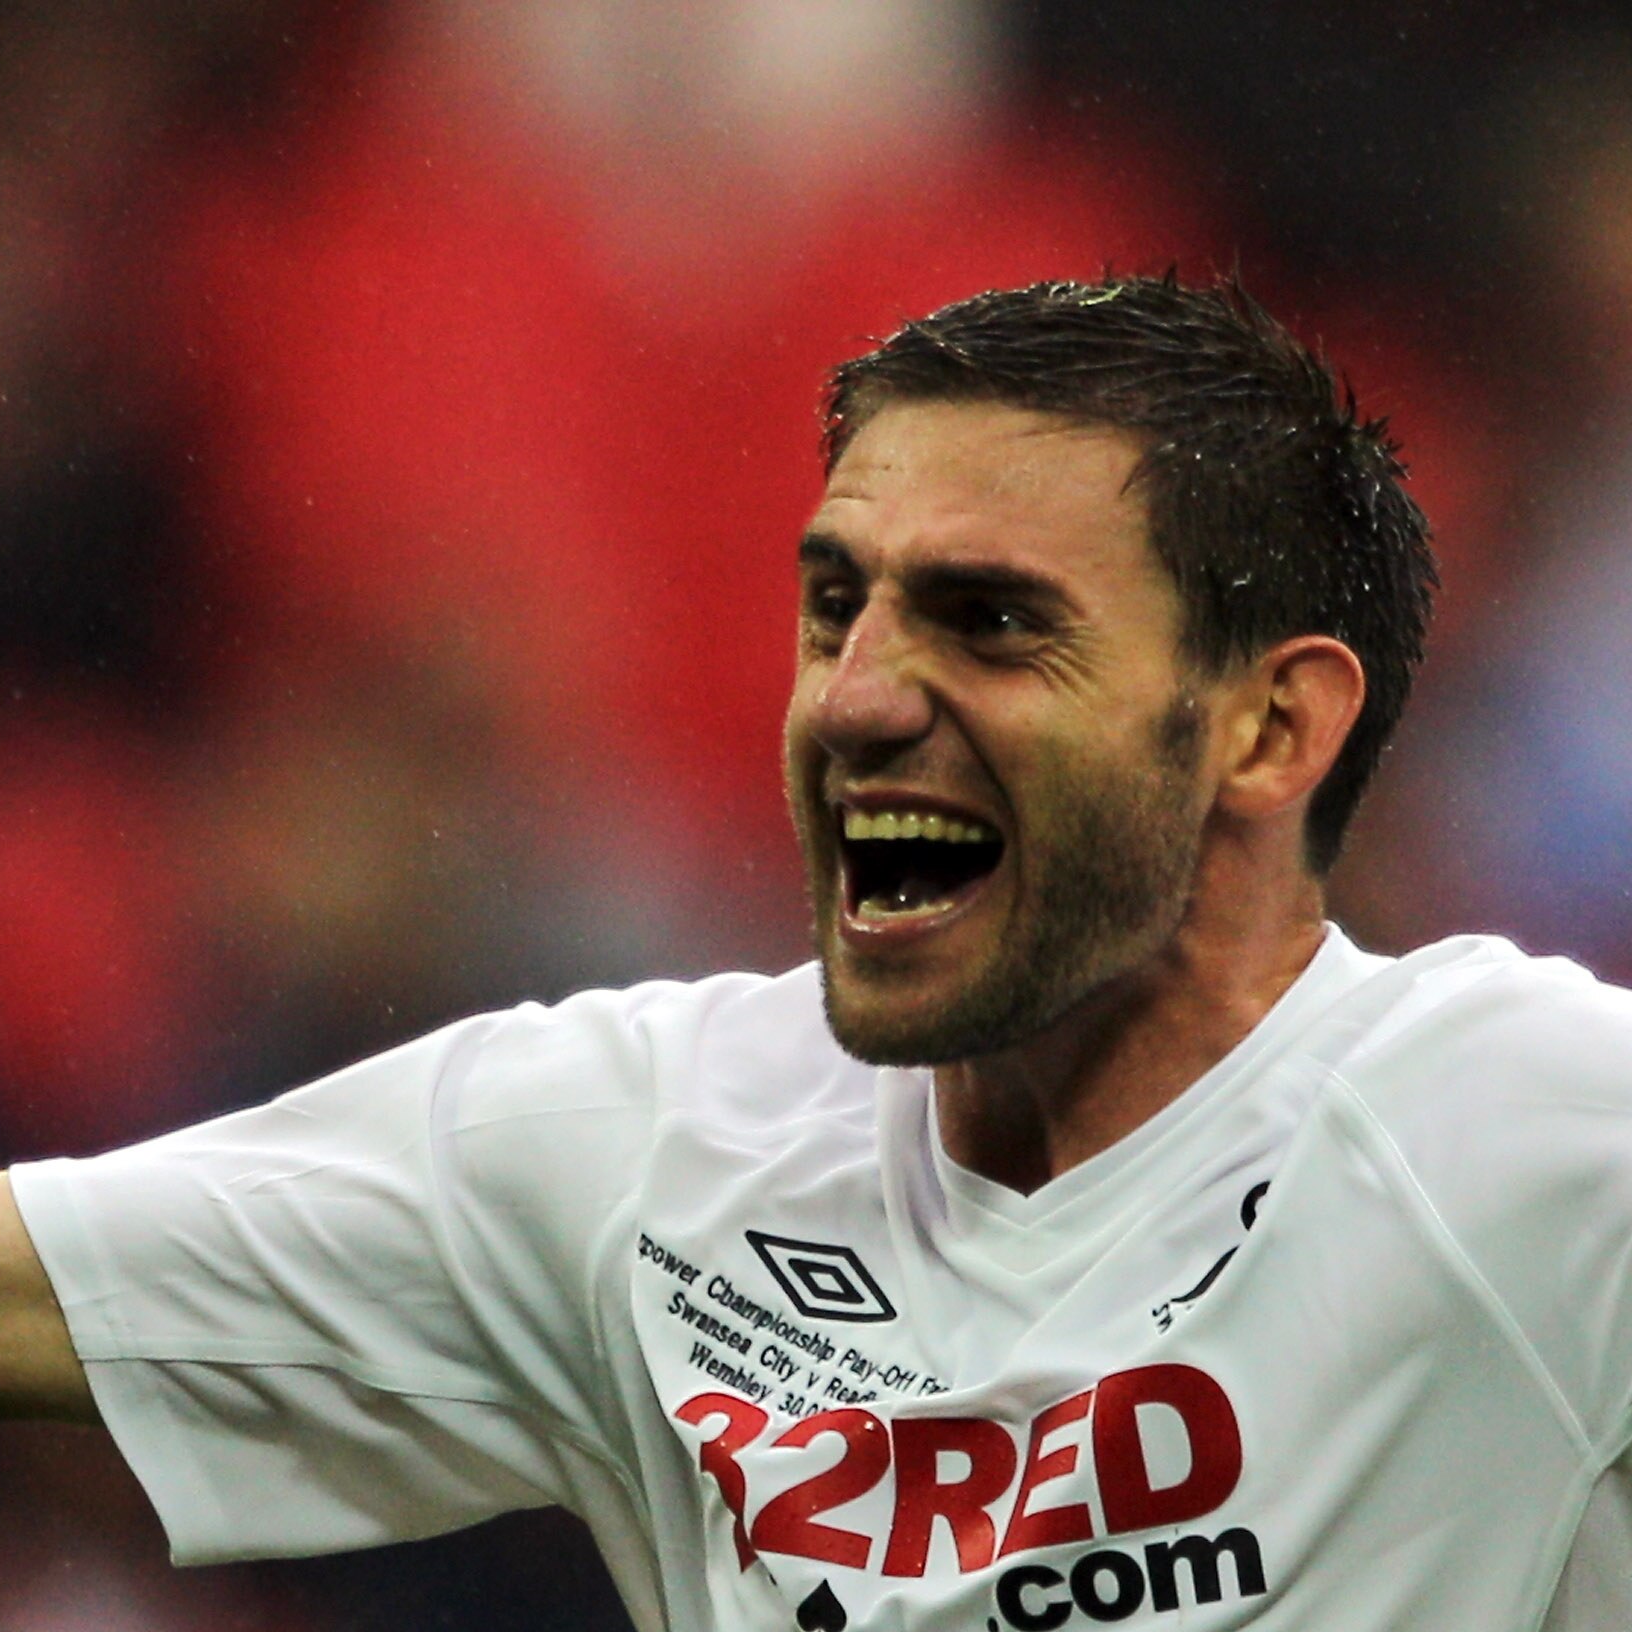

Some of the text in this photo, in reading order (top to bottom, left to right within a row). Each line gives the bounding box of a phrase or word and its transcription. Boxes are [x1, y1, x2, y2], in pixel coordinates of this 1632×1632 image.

[639, 1233, 701, 1286] power
[707, 1274, 836, 1363] Championship
[839, 1348, 917, 1390] Play-Off
[667, 1291, 751, 1354] Swansea
[759, 1344, 800, 1382] City
[807, 1372, 820, 1389] v
[689, 1341, 774, 1403] Wembley
[673, 1363, 1243, 1578] 32RED
